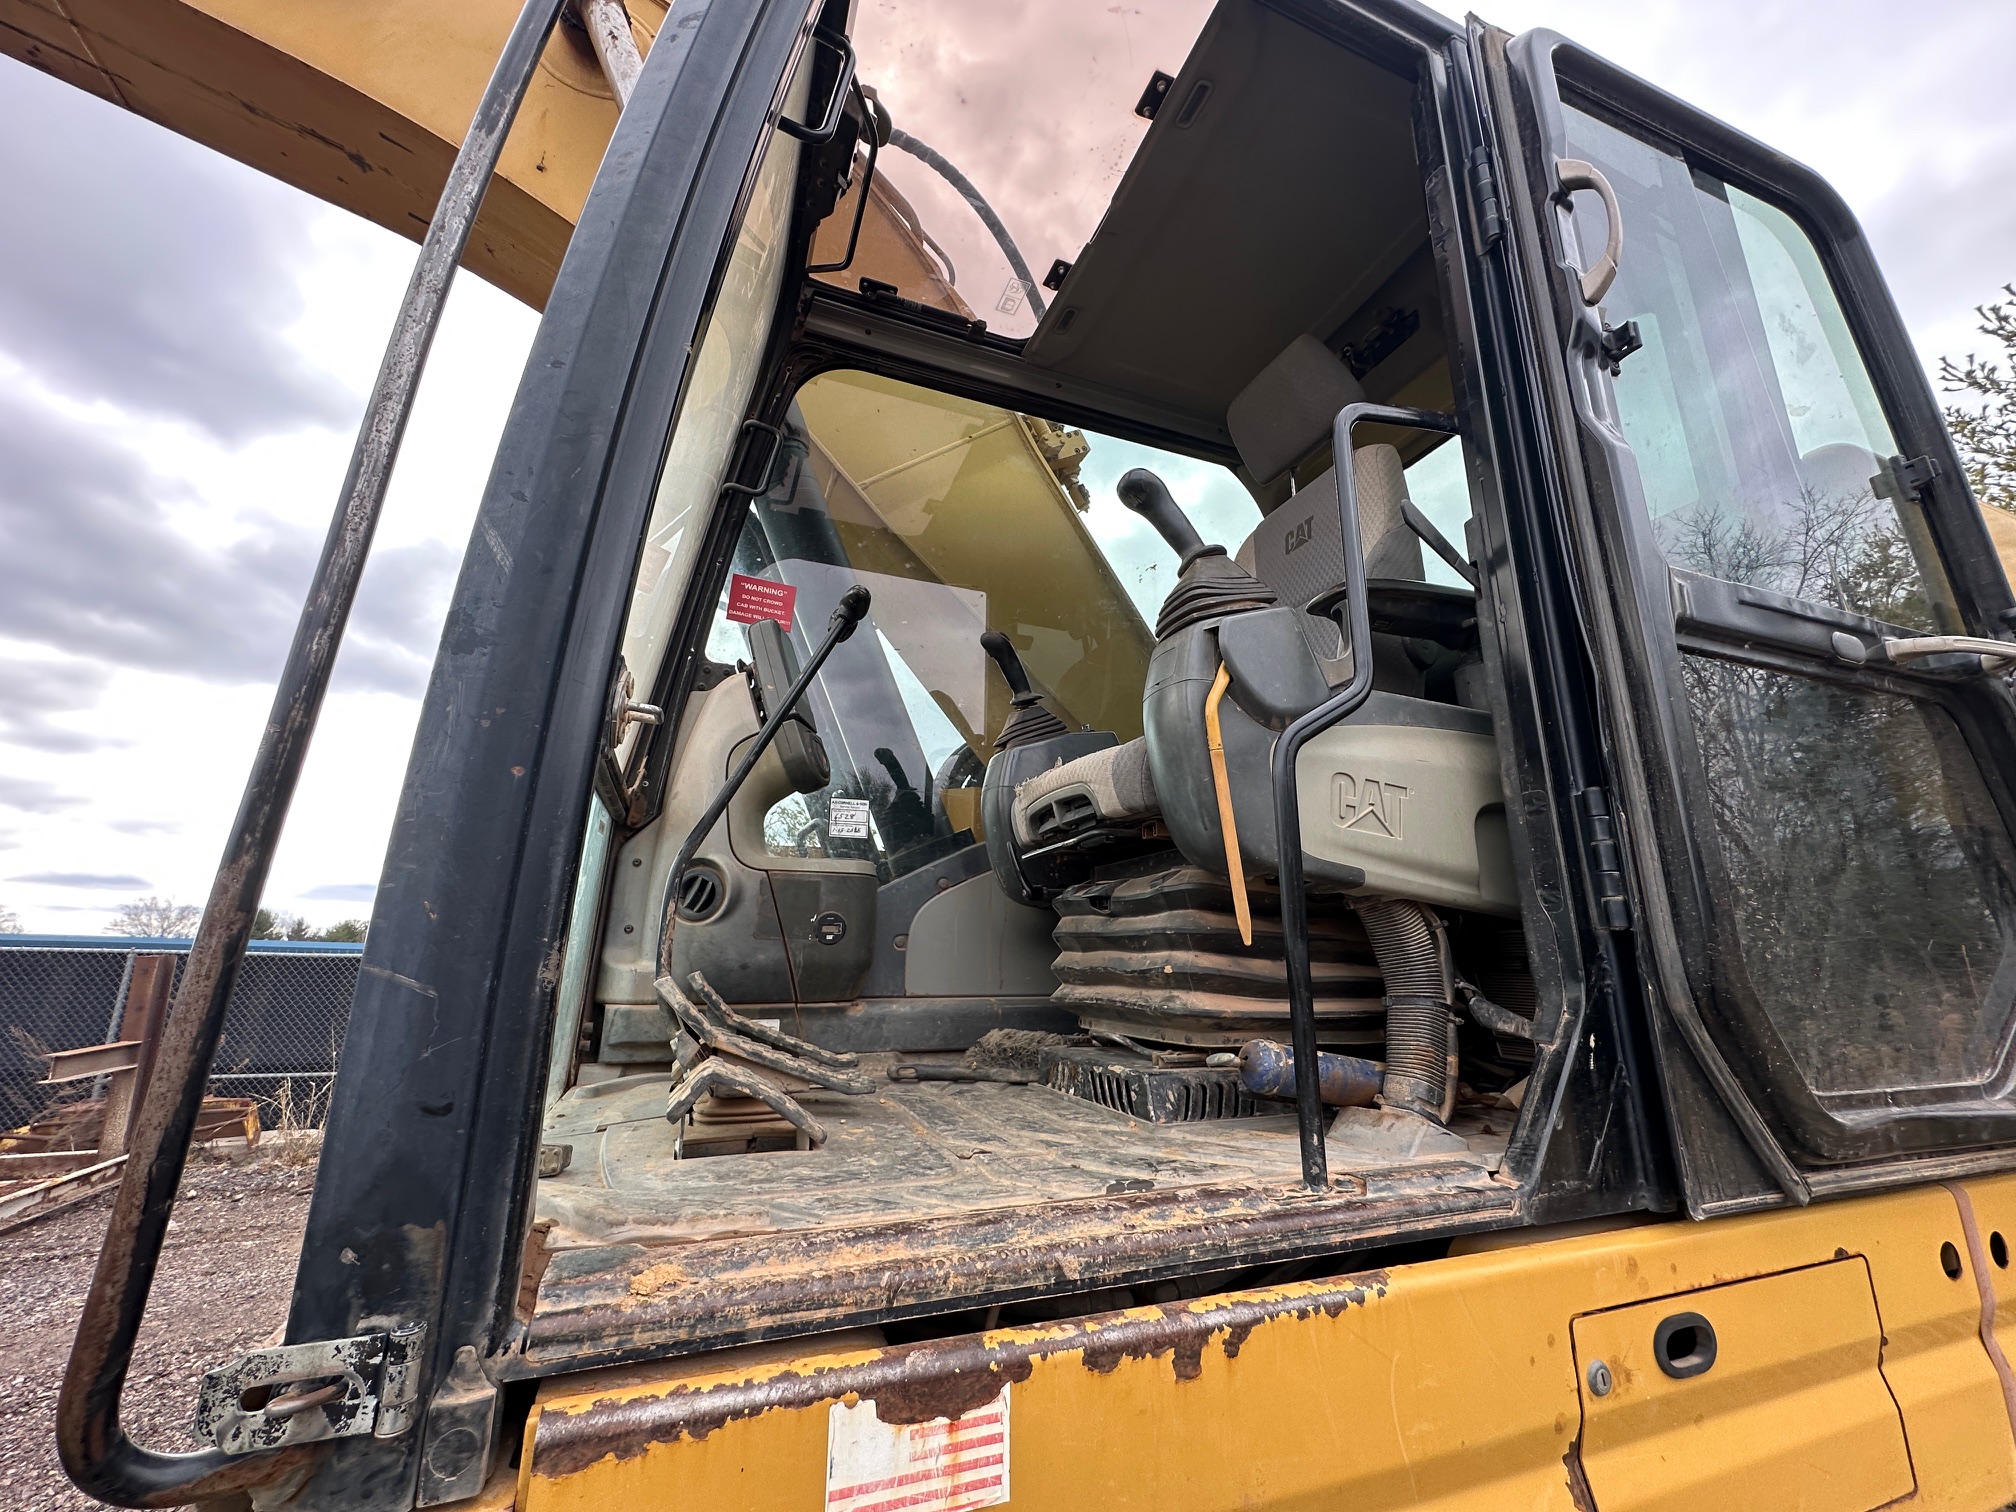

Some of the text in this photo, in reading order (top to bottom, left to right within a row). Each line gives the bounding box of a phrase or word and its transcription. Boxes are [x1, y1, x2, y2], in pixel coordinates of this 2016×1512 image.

[1285, 515, 1314, 555] CAT
[728, 610, 752, 618] DAMAGE
[763, 598, 783, 606] CROWD
[1329, 771, 1409, 840] CAT
